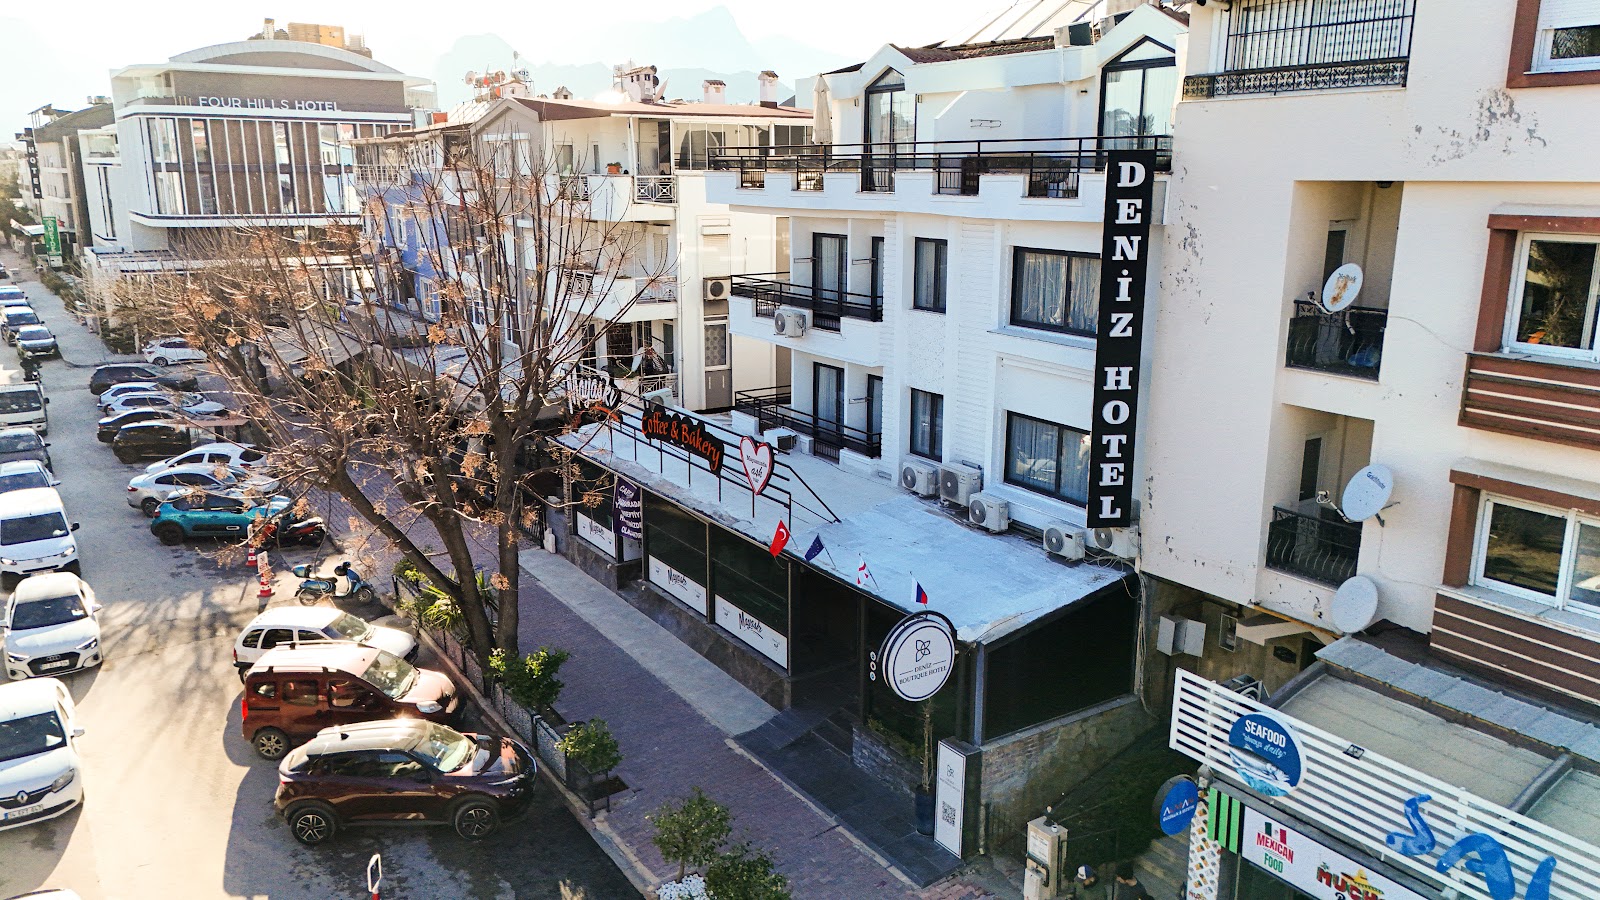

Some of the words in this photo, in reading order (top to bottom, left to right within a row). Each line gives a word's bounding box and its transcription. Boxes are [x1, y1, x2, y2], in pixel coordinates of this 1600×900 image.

[198, 96, 242, 108] FOUR
[247, 98, 289, 110] HILLS
[295, 100, 342, 112] HOTEL
[28, 146, 41, 195] HOTEL
[641, 411, 669, 435] Coffee
[670, 420, 679, 440] &
[681, 423, 721, 471] Bakery
[1098, 366, 1134, 519] HOTEL
[899, 670, 928, 685] BOUTIQUE
[928, 666, 947, 676] HOTEL
[1244, 719, 1287, 748] SEAFOOD
[1256, 832, 1294, 865] MEXICAN
[1263, 853, 1284, 874] FOOD
